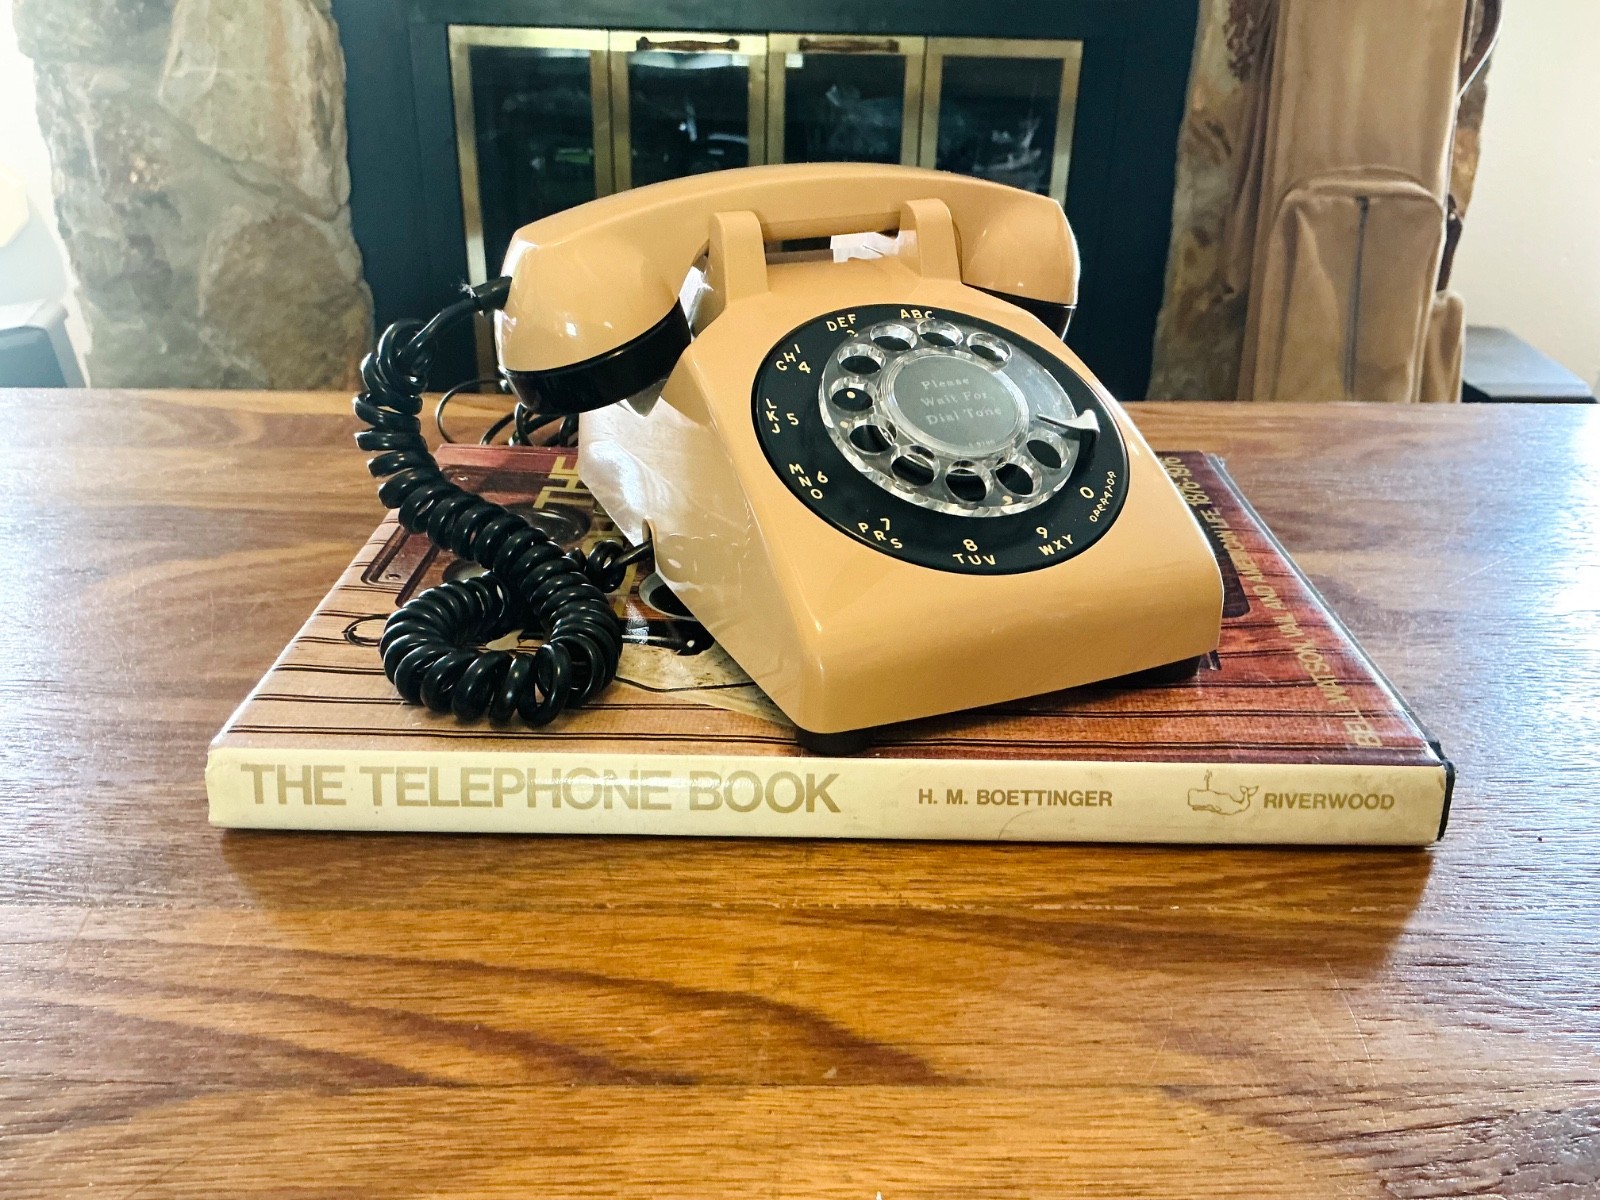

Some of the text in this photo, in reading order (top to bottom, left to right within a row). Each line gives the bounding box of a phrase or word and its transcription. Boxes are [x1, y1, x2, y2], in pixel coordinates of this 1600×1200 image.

[826, 313, 857, 332] DEF
[900, 308, 936, 320] ABC
[776, 344, 801, 372] GHI
[798, 361, 811, 374] 4
[920, 378, 969, 390] Please
[920, 391, 987, 407] Wait For
[786, 413, 799, 426] 5
[925, 407, 1002, 425] Dial Tone
[789, 463, 824, 500] MNO
[817, 471, 829, 484] 6
[1089, 471, 1117, 523] OPERATOR
[880, 518, 891, 531] 7
[1036, 527, 1048, 539] 9
[858, 522, 903, 549] PRS
[963, 539, 978, 552] 8
[1039, 534, 1074, 556] WXY
[953, 553, 996, 566] TUV
[1253, 585, 1287, 610] AND
[241, 763, 842, 814] THE TELEPHONE BOOK
[918, 788, 1113, 807] H. M. BOETTINGER
[1263, 793, 1396, 812] RIVERWOOD
